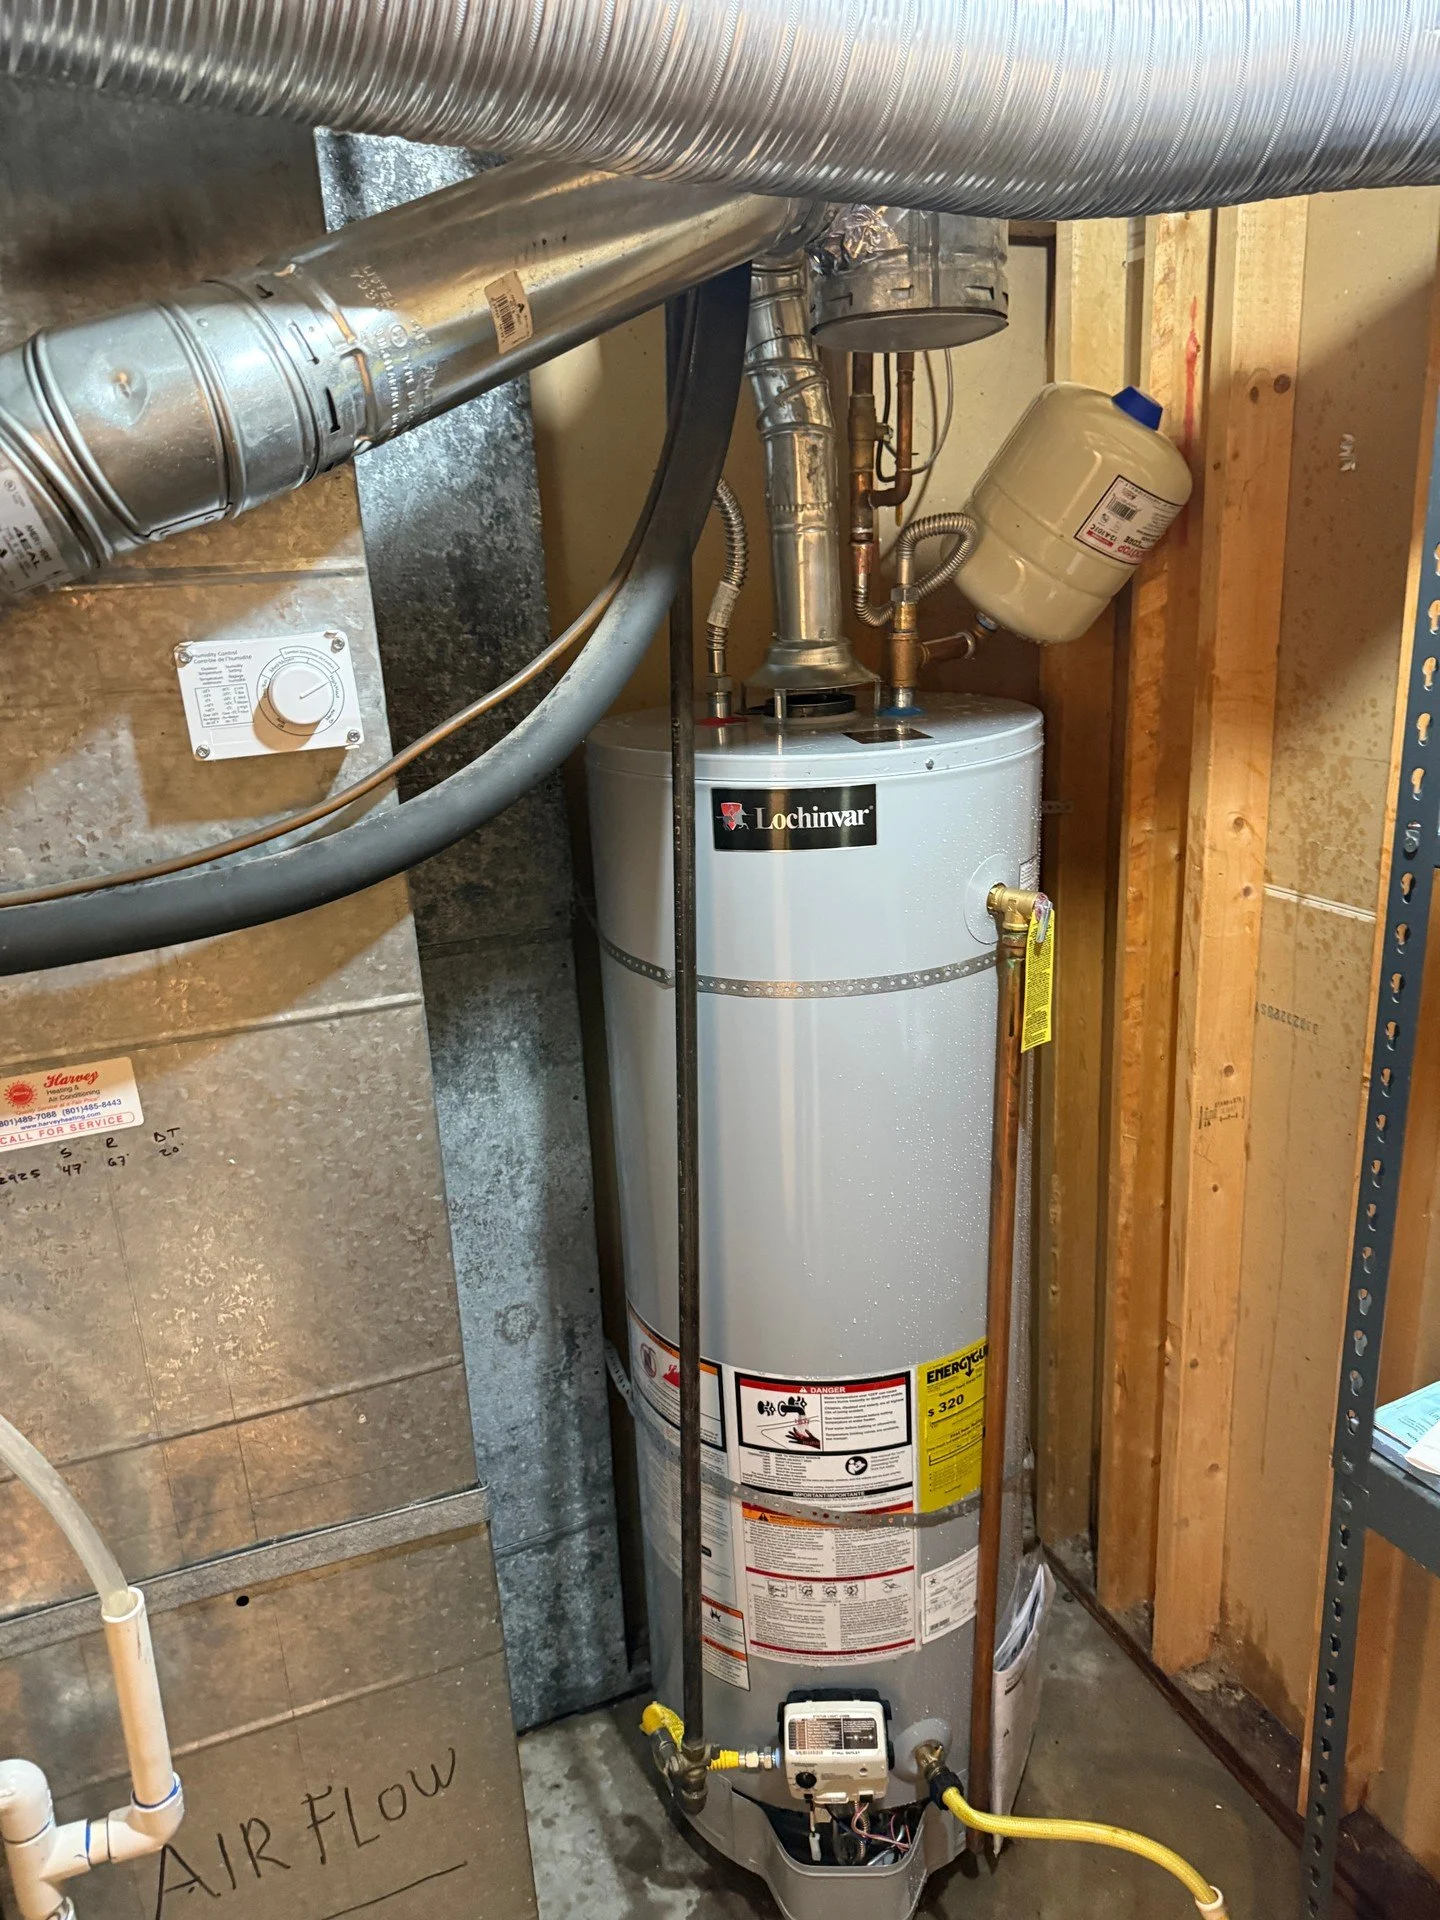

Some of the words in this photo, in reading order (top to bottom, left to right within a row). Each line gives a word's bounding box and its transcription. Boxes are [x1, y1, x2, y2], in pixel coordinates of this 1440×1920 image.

[755, 805, 870, 830] Lochinvar
[44, 1070, 100, 1088] Harvey
[47, 1086, 73, 1095] Heating
[60, 1089, 101, 1101] Conditioning
[62, 1098, 122, 1116] (801)485-8443
[21, 1111, 101, 1130] www.harveyheating.com
[0, 1133, 33, 1145] CALL
[39, 1126, 64, 1138] FOR
[70, 1115, 124, 1131] SERVICE
[60, 1147, 73, 1159] S
[106, 1138, 118, 1148] R
[939, 1394, 964, 1412] 320
[154, 1816, 292, 1920] AIR
[301, 1747, 457, 1865] FLOW
